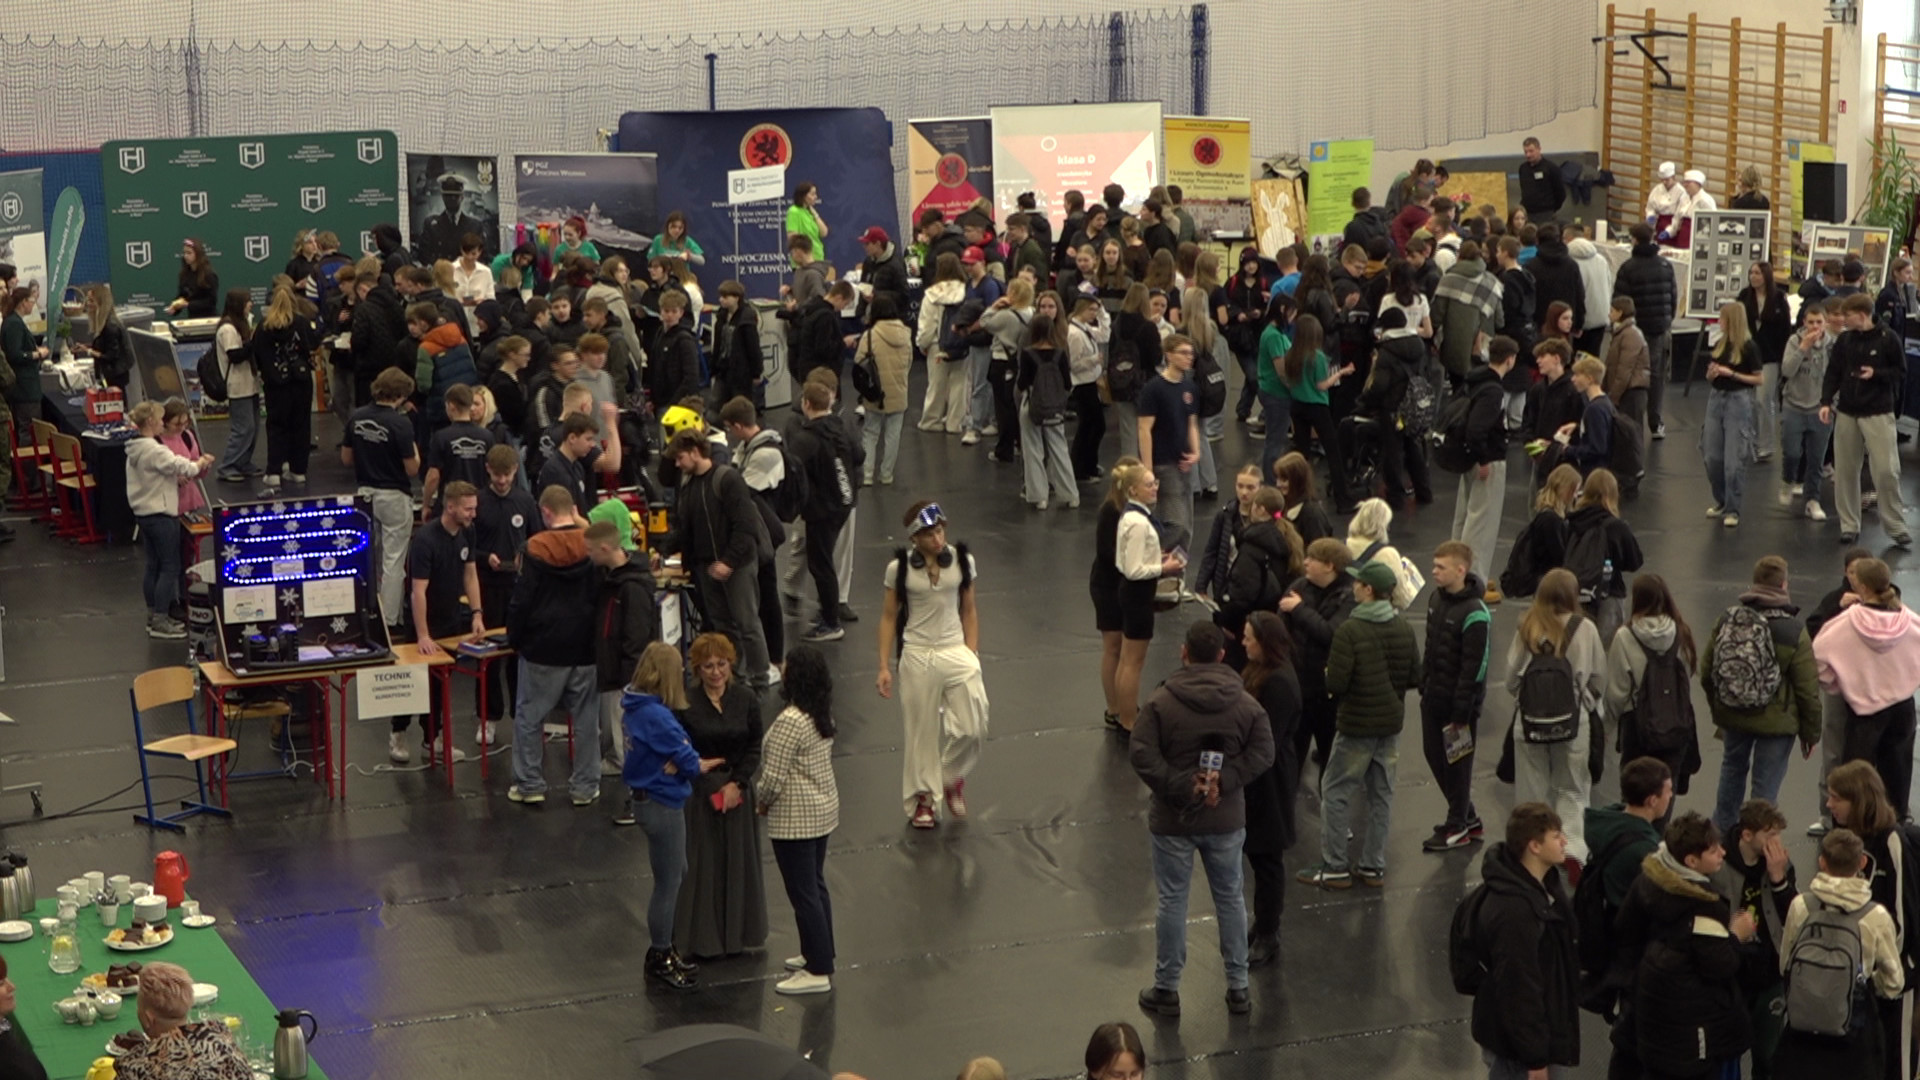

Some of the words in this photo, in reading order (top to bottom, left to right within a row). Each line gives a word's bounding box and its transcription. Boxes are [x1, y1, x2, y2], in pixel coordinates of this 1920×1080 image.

[1057, 155, 1086, 165] klasa
[1087, 154, 1096, 164] D
[721, 253, 787, 264] NOWOCZESNA
[740, 266, 746, 275] Z
[374, 671, 412, 682] TECHNIK
